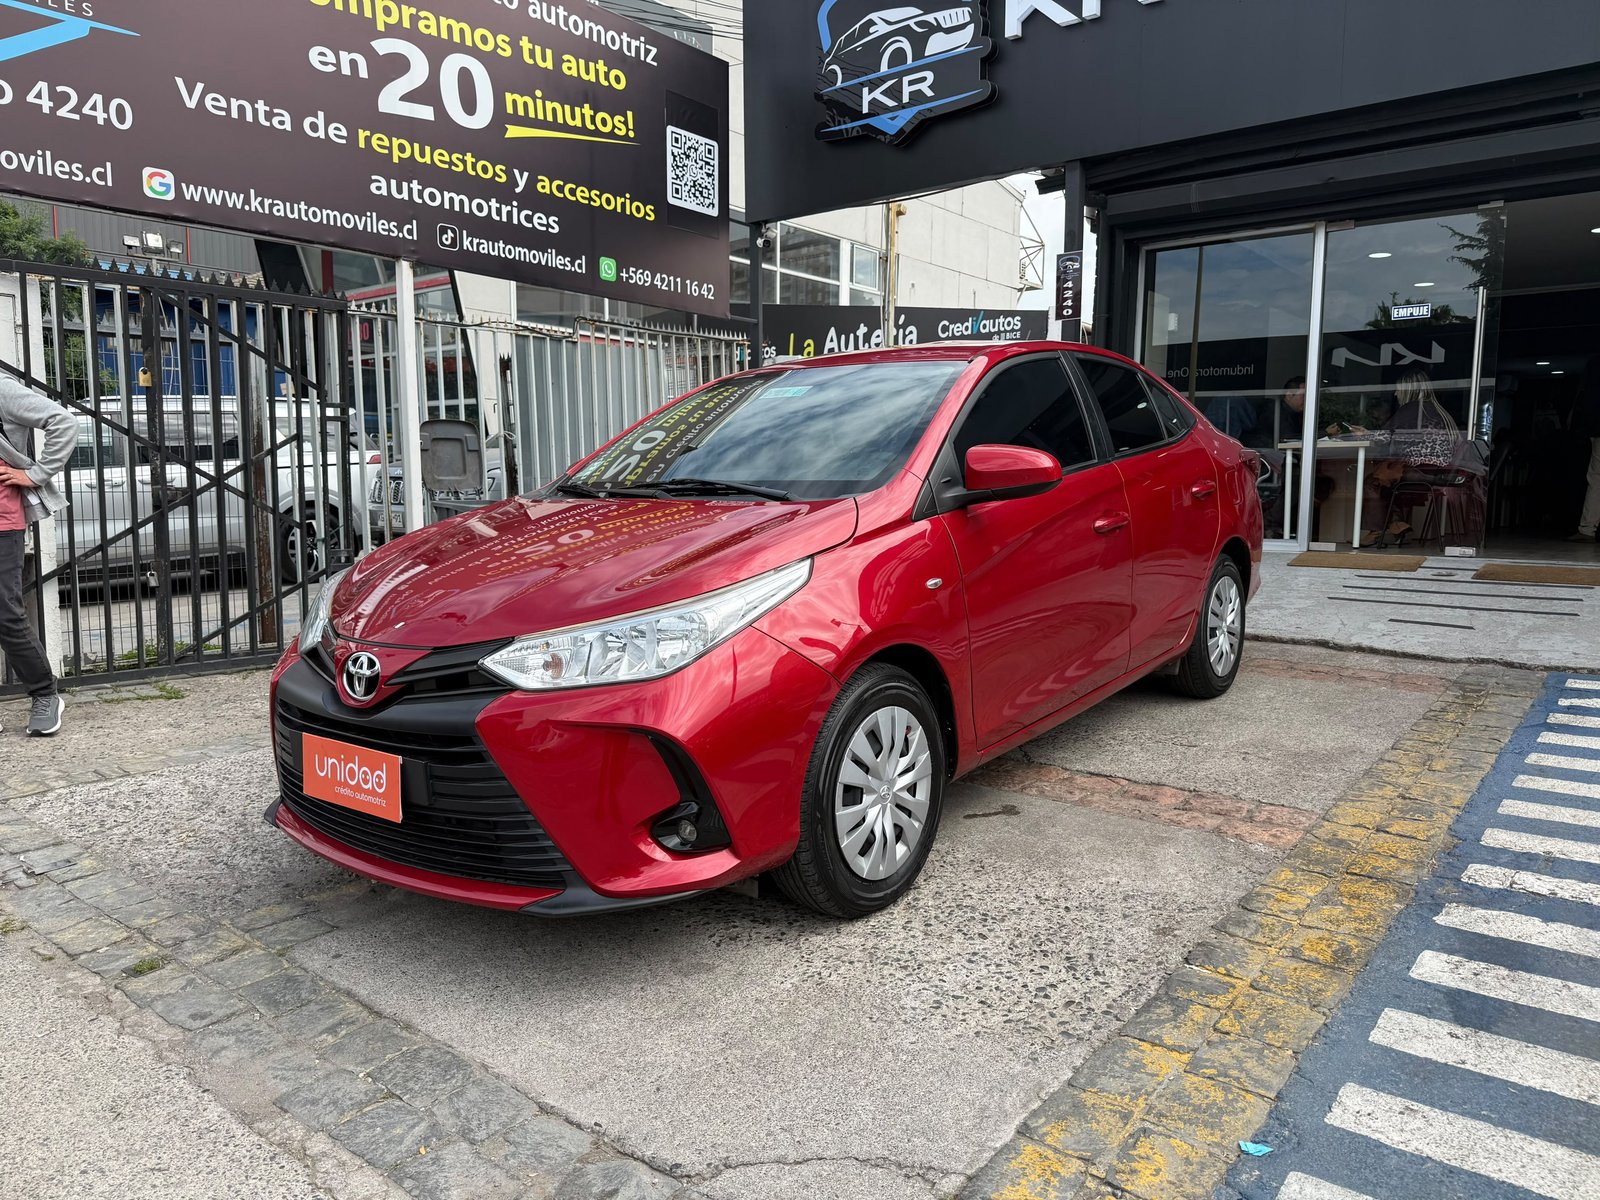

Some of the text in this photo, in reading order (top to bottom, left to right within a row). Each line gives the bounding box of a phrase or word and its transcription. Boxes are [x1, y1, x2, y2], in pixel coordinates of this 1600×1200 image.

[310, 0, 627, 91] mpramos tu auto
[527, 0, 658, 67] automotriz
[26, 80, 133, 130] 4240
[308, 37, 635, 138] en 20 minutos!
[861, 69, 936, 114] KR
[174, 76, 655, 221] Venta de repuestos y accesorios
[180, 182, 419, 241] www.krautomoviles.cl
[369, 173, 560, 234] automotrices
[462, 230, 586, 275] krautomoviles.cl
[619, 268, 652, 287] +569
[653, 272, 682, 294] 4211
[1062, 280, 1074, 316] 4240
[823, 313, 918, 354] Auteía
[1393, 305, 1429, 318] EMPUJE
[314, 753, 387, 794] unidad
[334, 785, 387, 808] crédito automotriz
